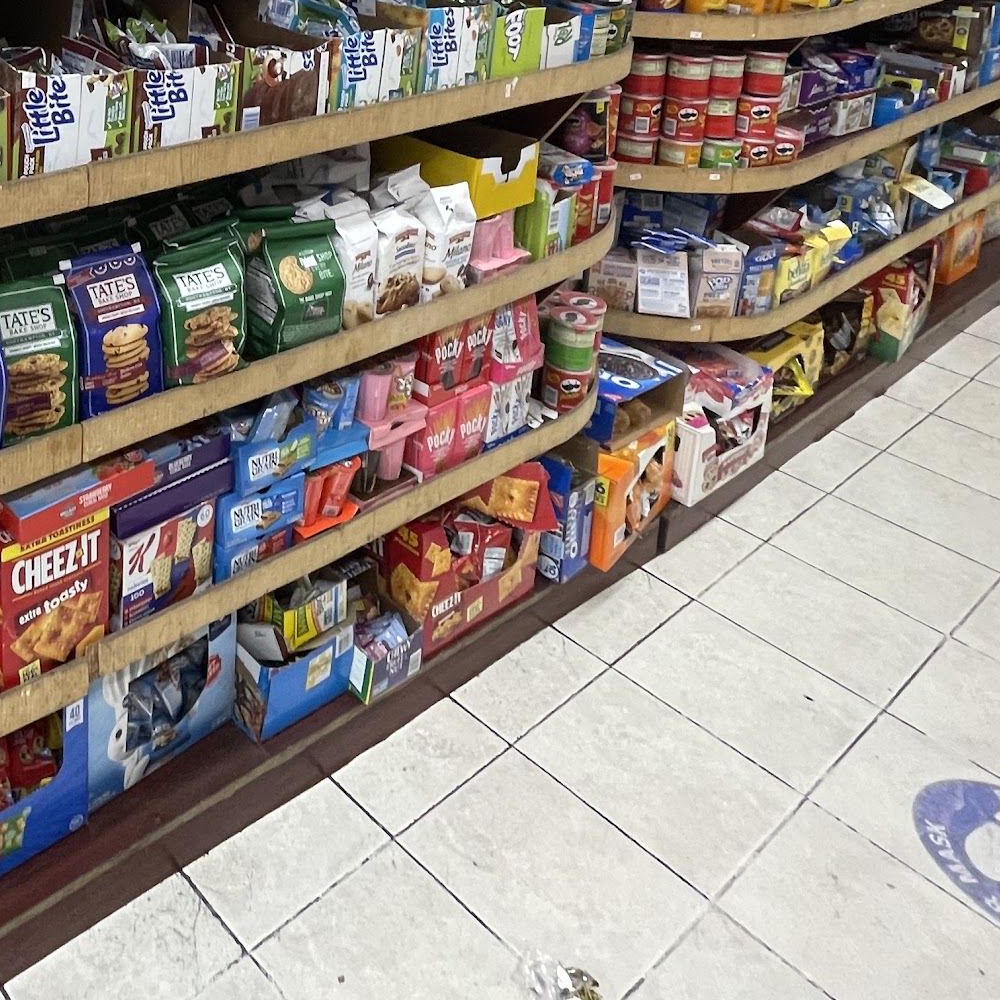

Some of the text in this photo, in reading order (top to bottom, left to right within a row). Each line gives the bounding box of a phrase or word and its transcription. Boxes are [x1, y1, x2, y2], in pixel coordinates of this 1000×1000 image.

[345, 36, 367, 83] Little
[361, 30, 378, 67] Bite
[146, 69, 176, 123] Little
[166, 69, 189, 104] Bit
[50, 75, 75, 126] Bite
[25, 88, 61, 145] Little
[89, 277, 136, 299] TATE'S
[176, 267, 225, 288] TATE'S
[1, 308, 52, 328] TATE'S
[435, 341, 464, 364] POCKY
[426, 425, 456, 453] POCKY
[460, 413, 487, 440] POCKY
[250, 449, 279, 470] NUTRI
[232, 501, 261, 519] NUTRI
[48, 515, 95, 541] TOASTINESS
[128, 532, 156, 576] K
[18, 577, 90, 626] extra toasty
[69, 704, 81, 719] 40
